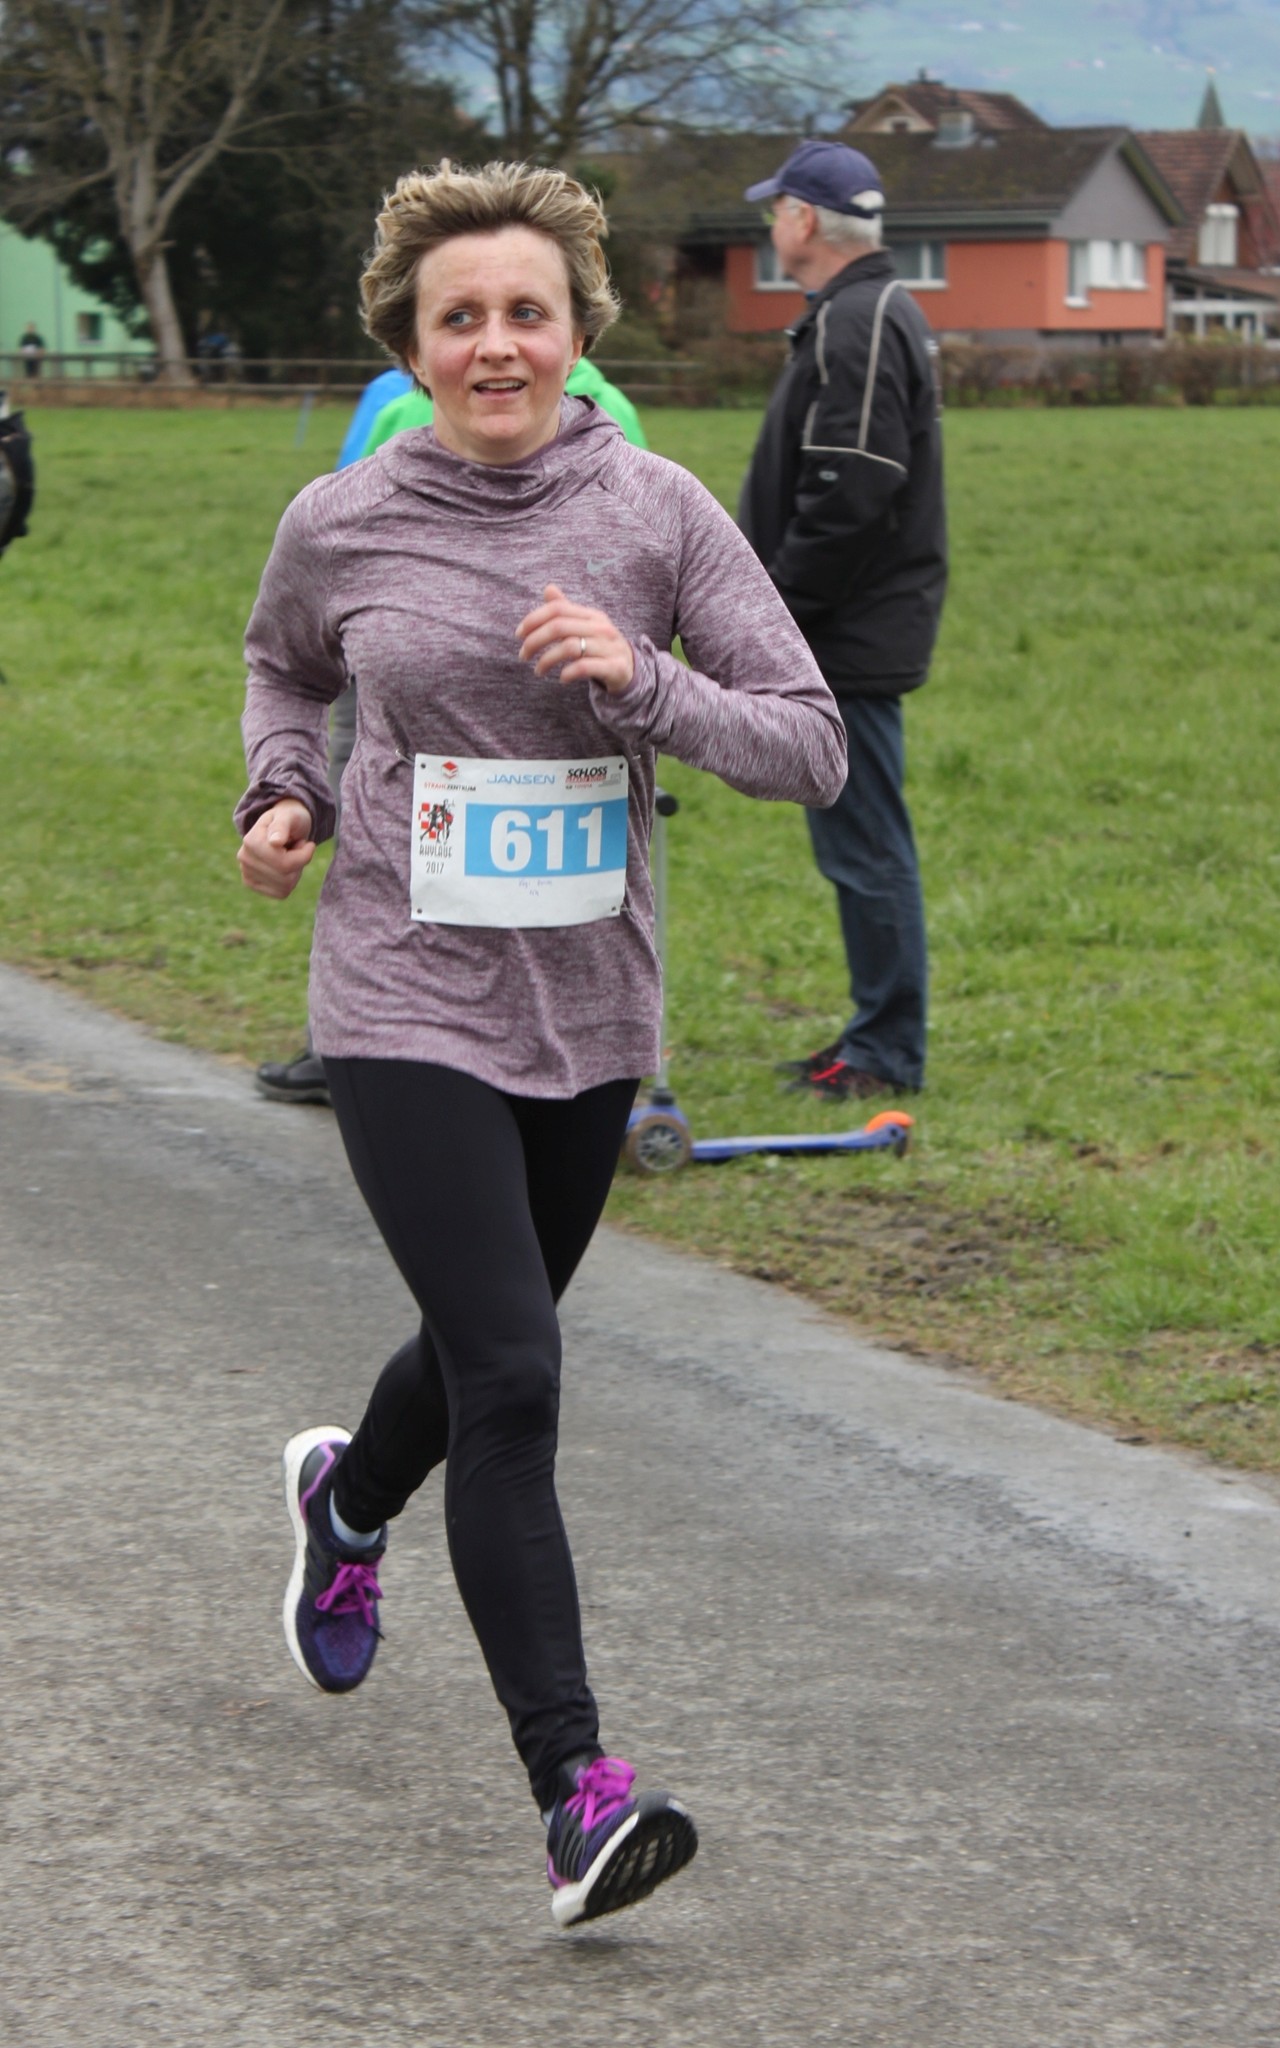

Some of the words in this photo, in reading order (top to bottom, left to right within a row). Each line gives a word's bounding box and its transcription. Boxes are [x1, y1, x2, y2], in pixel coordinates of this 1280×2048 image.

[567, 765, 608, 778] SCHLOSS
[486, 774, 556, 785] JANSEN
[490, 807, 603, 872] 611
[425, 861, 445, 875] 2017
